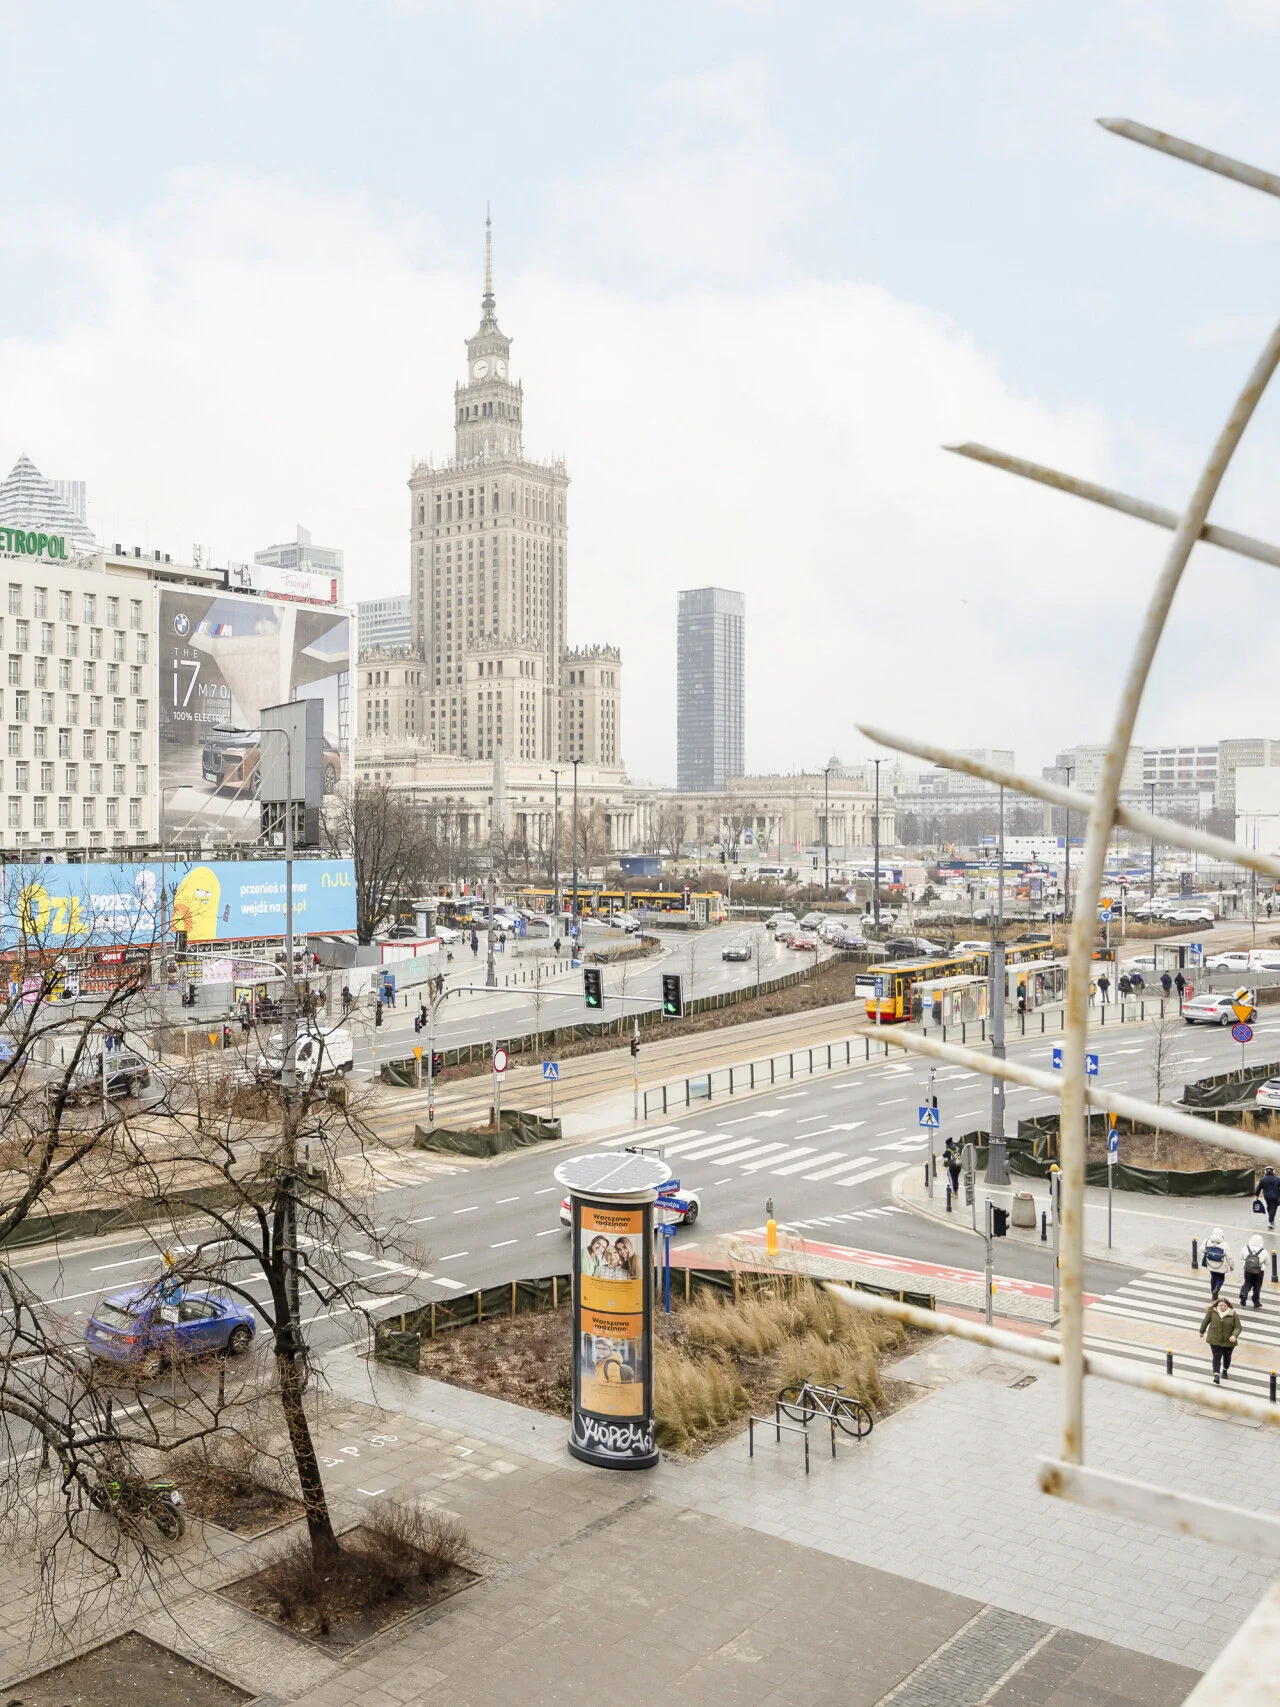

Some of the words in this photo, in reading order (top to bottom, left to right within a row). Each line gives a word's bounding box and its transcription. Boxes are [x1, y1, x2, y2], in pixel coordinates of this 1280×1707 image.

[174, 647, 199, 659] THE
[173, 659, 201, 707] i7
[173, 711, 193, 722] 100%
[194, 712, 230, 725] ELECTRIC
[240, 881, 279, 897] przenieś
[280, 883, 308, 894] nmer
[269, 904, 281, 914] na
[593, 1213, 631, 1222] Warszawa
[592, 1317, 630, 1326] Warszawa
[595, 1323, 627, 1331] rodzinna
